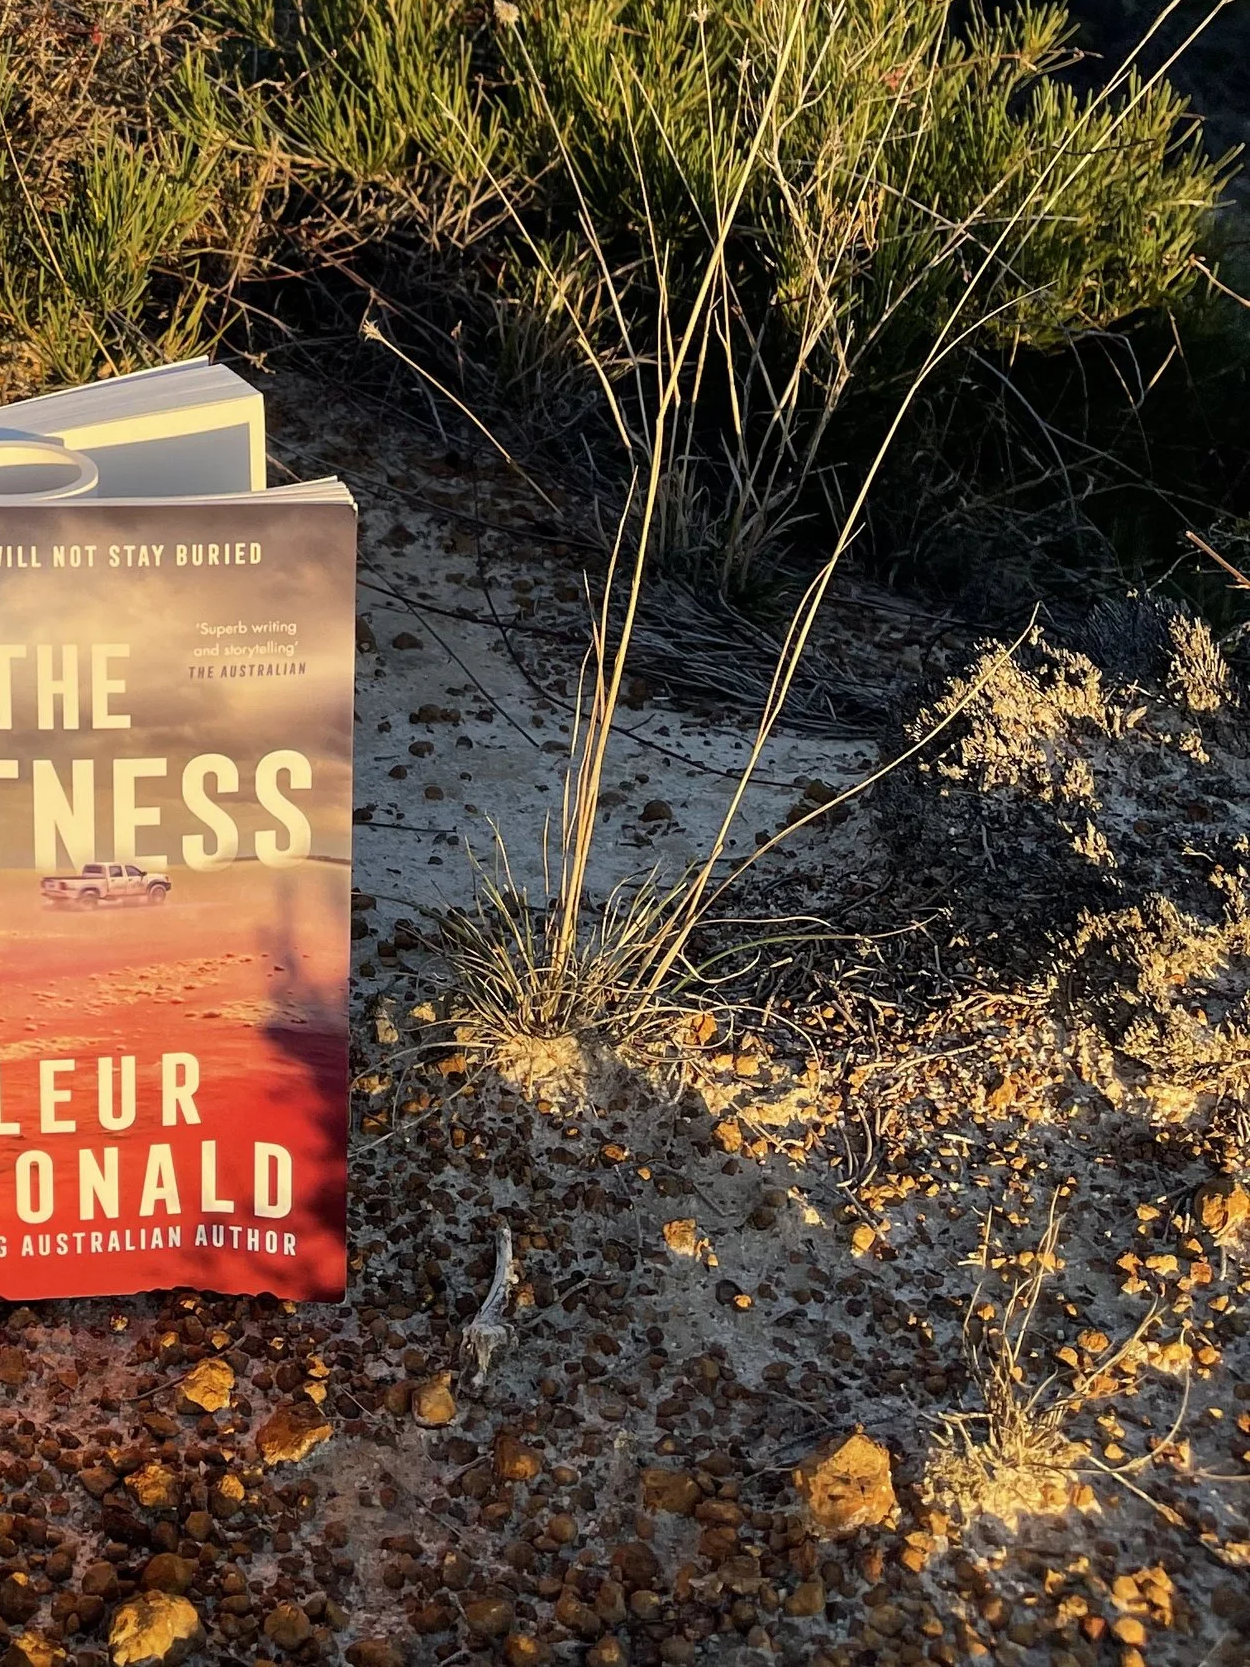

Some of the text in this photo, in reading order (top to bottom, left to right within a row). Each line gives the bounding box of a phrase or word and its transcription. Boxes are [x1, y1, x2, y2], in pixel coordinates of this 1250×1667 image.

[52, 544, 97, 568] NOT
[109, 544, 165, 567] STAY
[176, 542, 262, 566] BURIED
[252, 621, 297, 636] writing
[194, 643, 219, 657] and
[188, 662, 307, 679] THE AUSTRALIAN
[21, 1225, 181, 1257] AUSTRALIAN
[194, 1224, 296, 1256] AUTHOR
